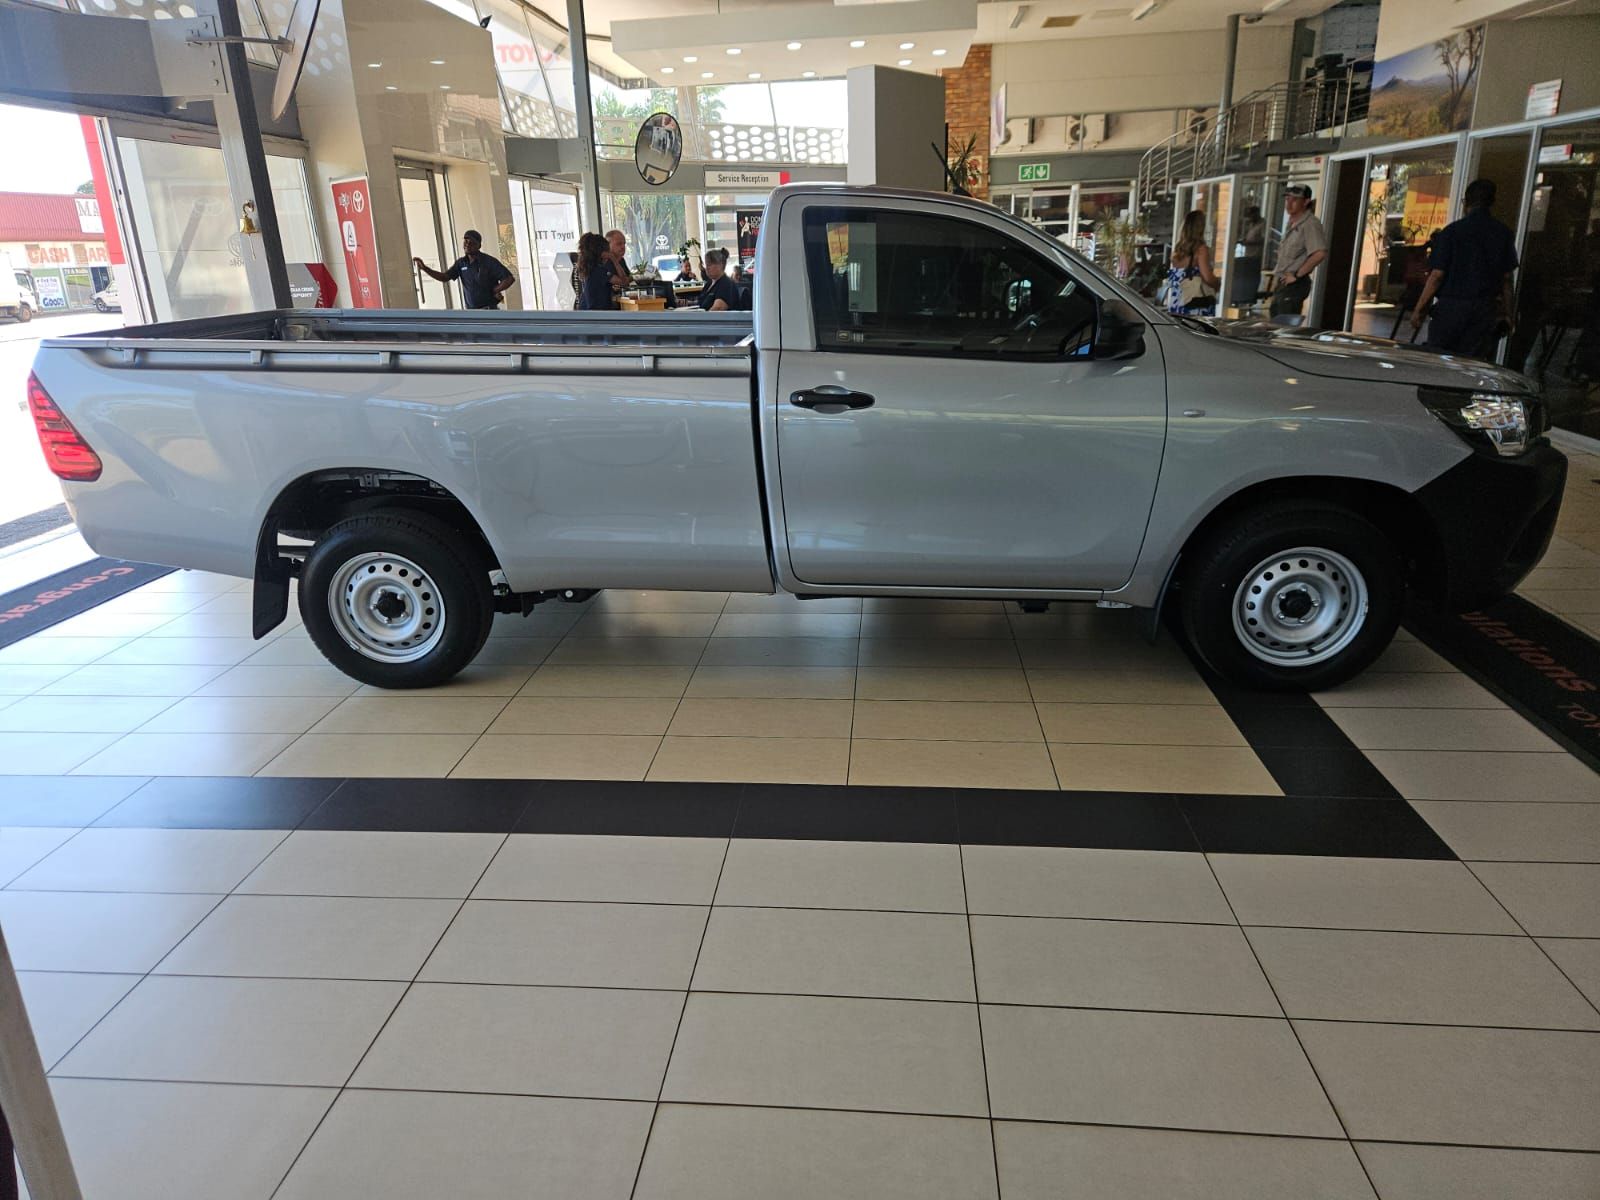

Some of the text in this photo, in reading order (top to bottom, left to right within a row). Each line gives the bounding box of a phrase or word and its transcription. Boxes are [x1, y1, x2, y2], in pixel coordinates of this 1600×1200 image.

[718, 173, 769, 184] Service Reception
[27, 246, 71, 264] CASH
